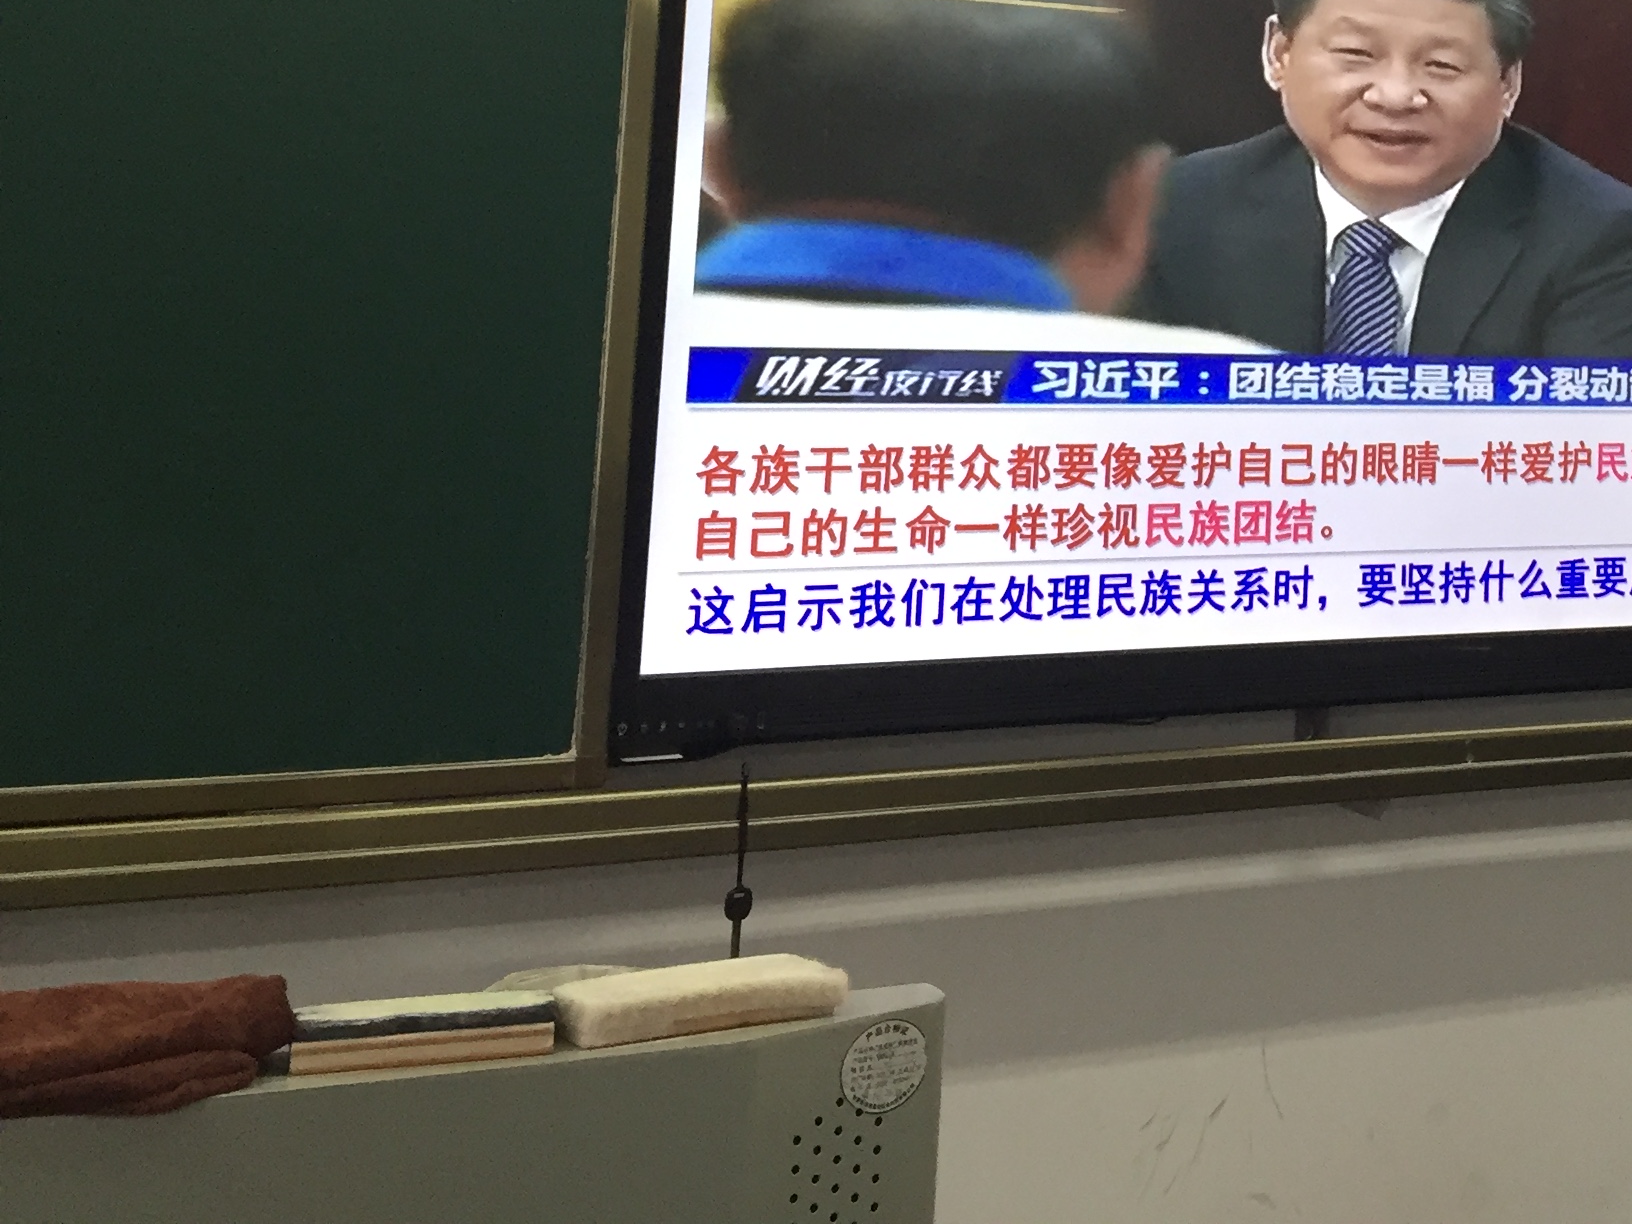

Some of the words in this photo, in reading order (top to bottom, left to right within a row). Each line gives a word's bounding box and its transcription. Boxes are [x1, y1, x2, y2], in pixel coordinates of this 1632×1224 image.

[695, 498, 1334, 561] 自己的生命一样珍视民族团结。
